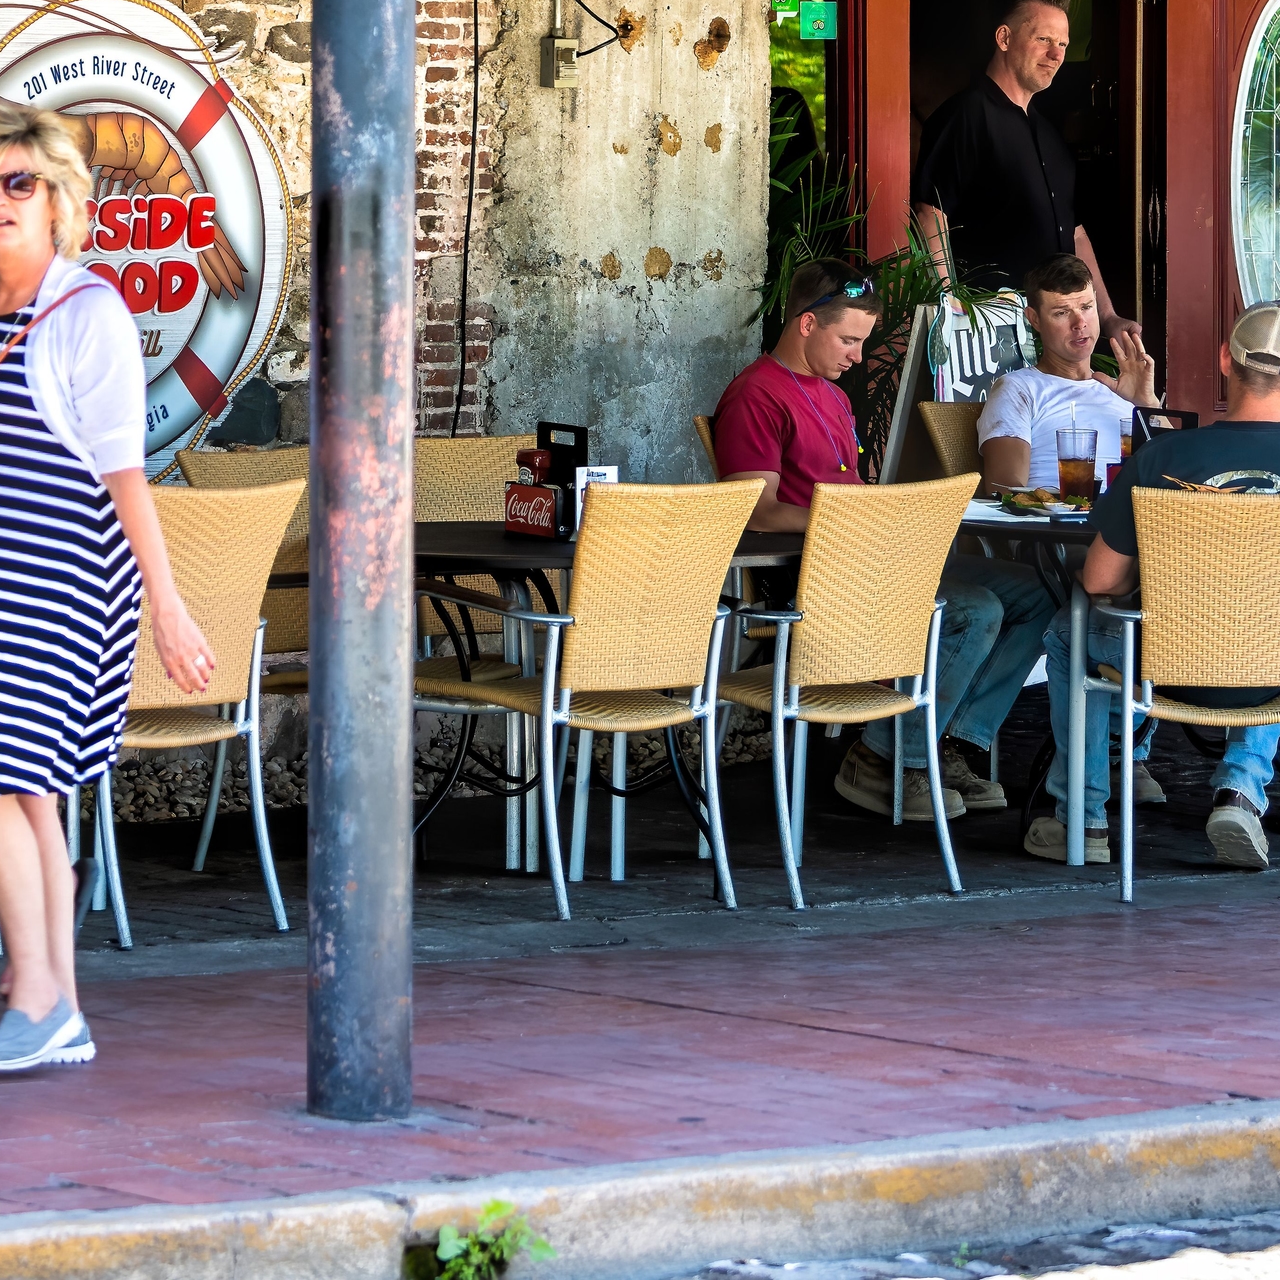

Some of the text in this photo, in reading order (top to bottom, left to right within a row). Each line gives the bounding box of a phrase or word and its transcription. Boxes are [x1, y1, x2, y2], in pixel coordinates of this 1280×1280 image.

[23, 55, 175, 100] 201 West River Street
[140, 330, 163, 358] ill
